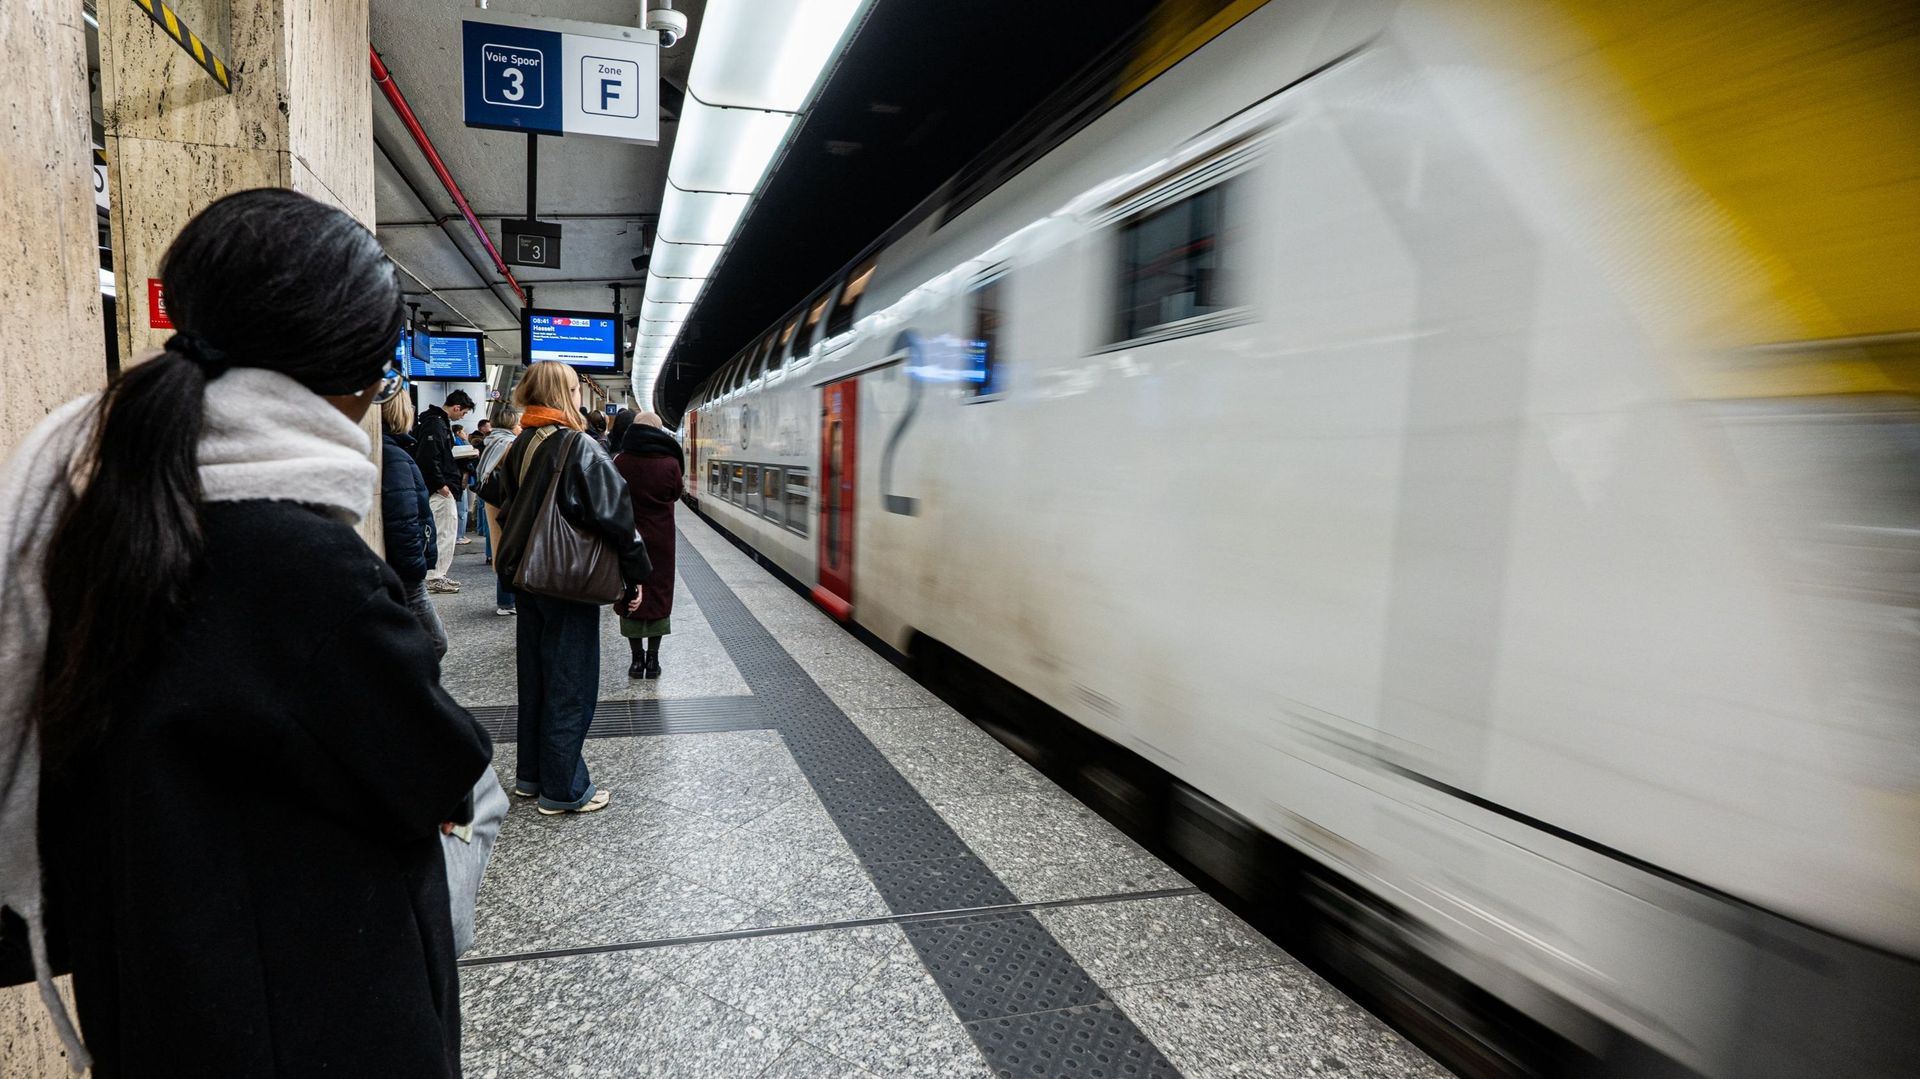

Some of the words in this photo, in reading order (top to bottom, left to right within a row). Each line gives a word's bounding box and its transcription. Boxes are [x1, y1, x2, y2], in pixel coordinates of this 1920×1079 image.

[486, 51, 508, 63] Voie
[510, 54, 540, 67] Spoor
[598, 64, 622, 76] Zone
[502, 67, 525, 101] 3
[600, 78, 622, 111] F
[532, 245, 541, 260] 3
[599, 320, 608, 328] IC
